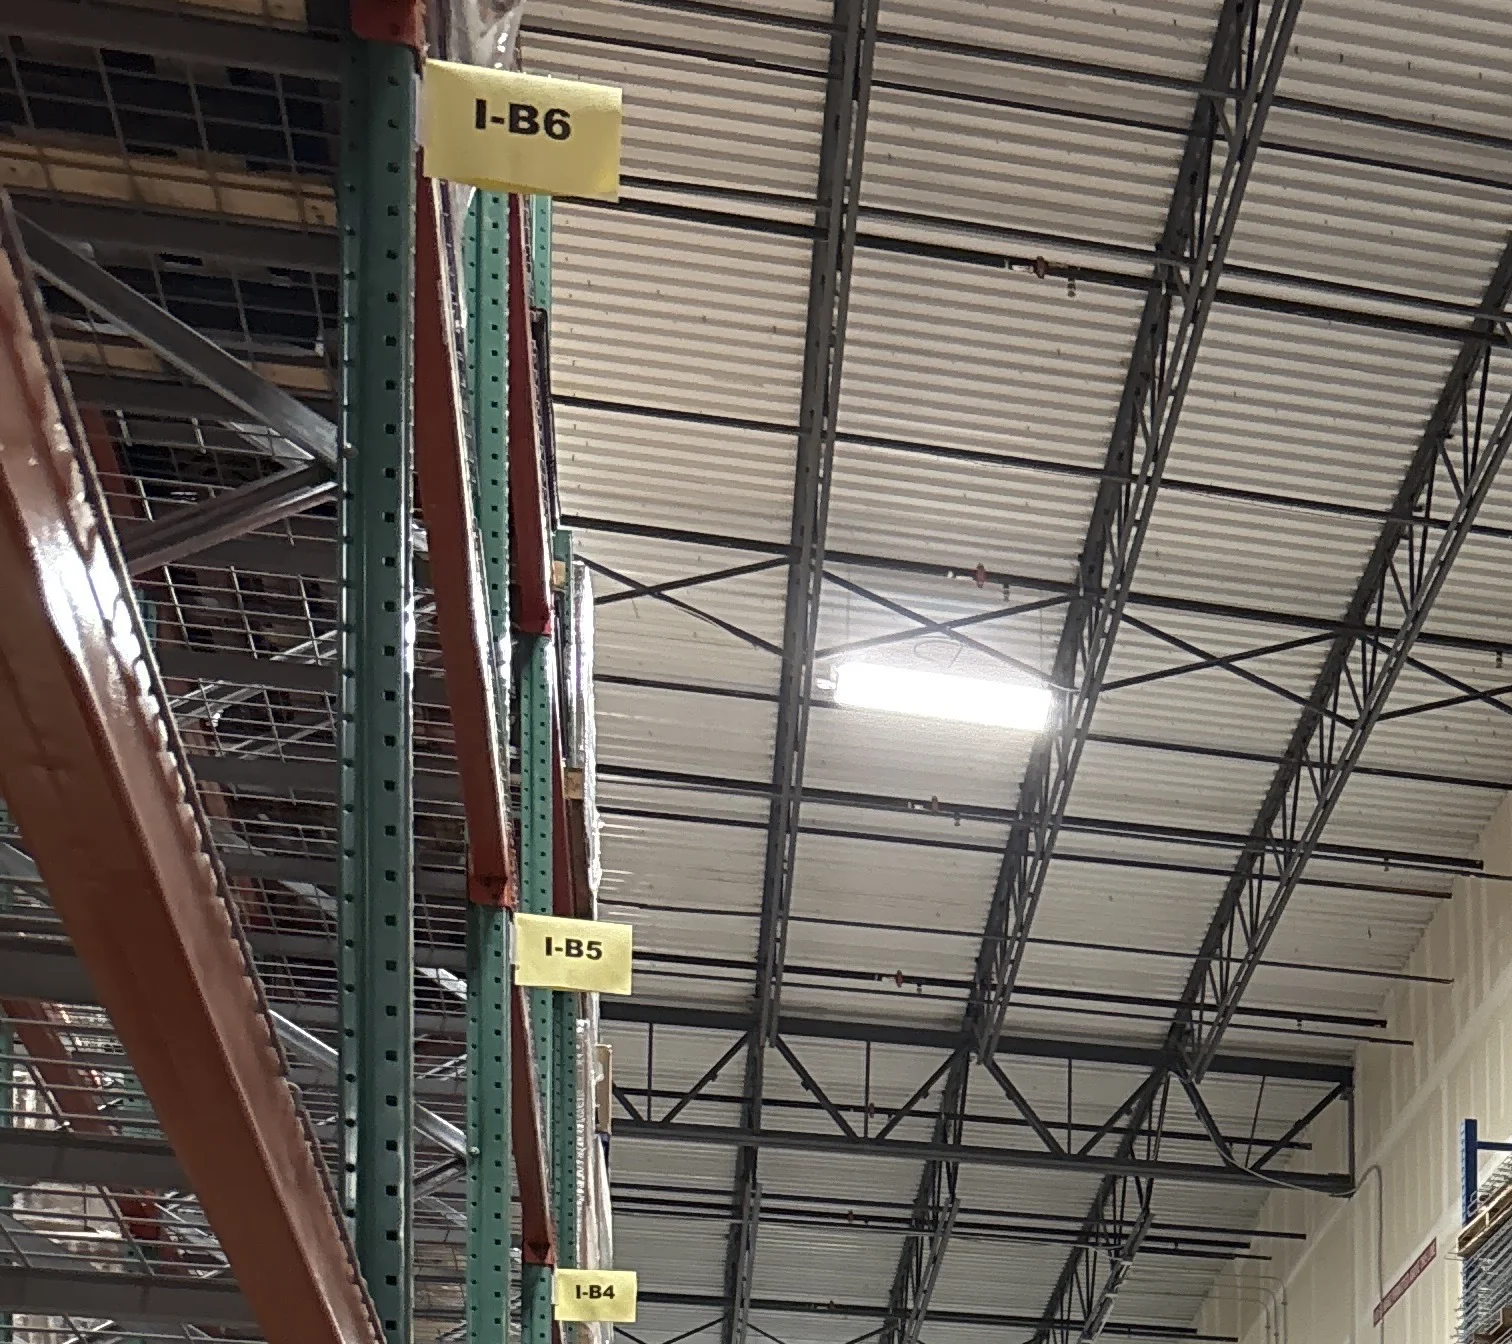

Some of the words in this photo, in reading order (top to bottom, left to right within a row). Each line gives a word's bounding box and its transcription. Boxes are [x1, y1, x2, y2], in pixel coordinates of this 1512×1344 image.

[475, 98, 571, 141] I-B6
[545, 936, 602, 961] I-B5
[575, 1284, 615, 1300] I-B4
